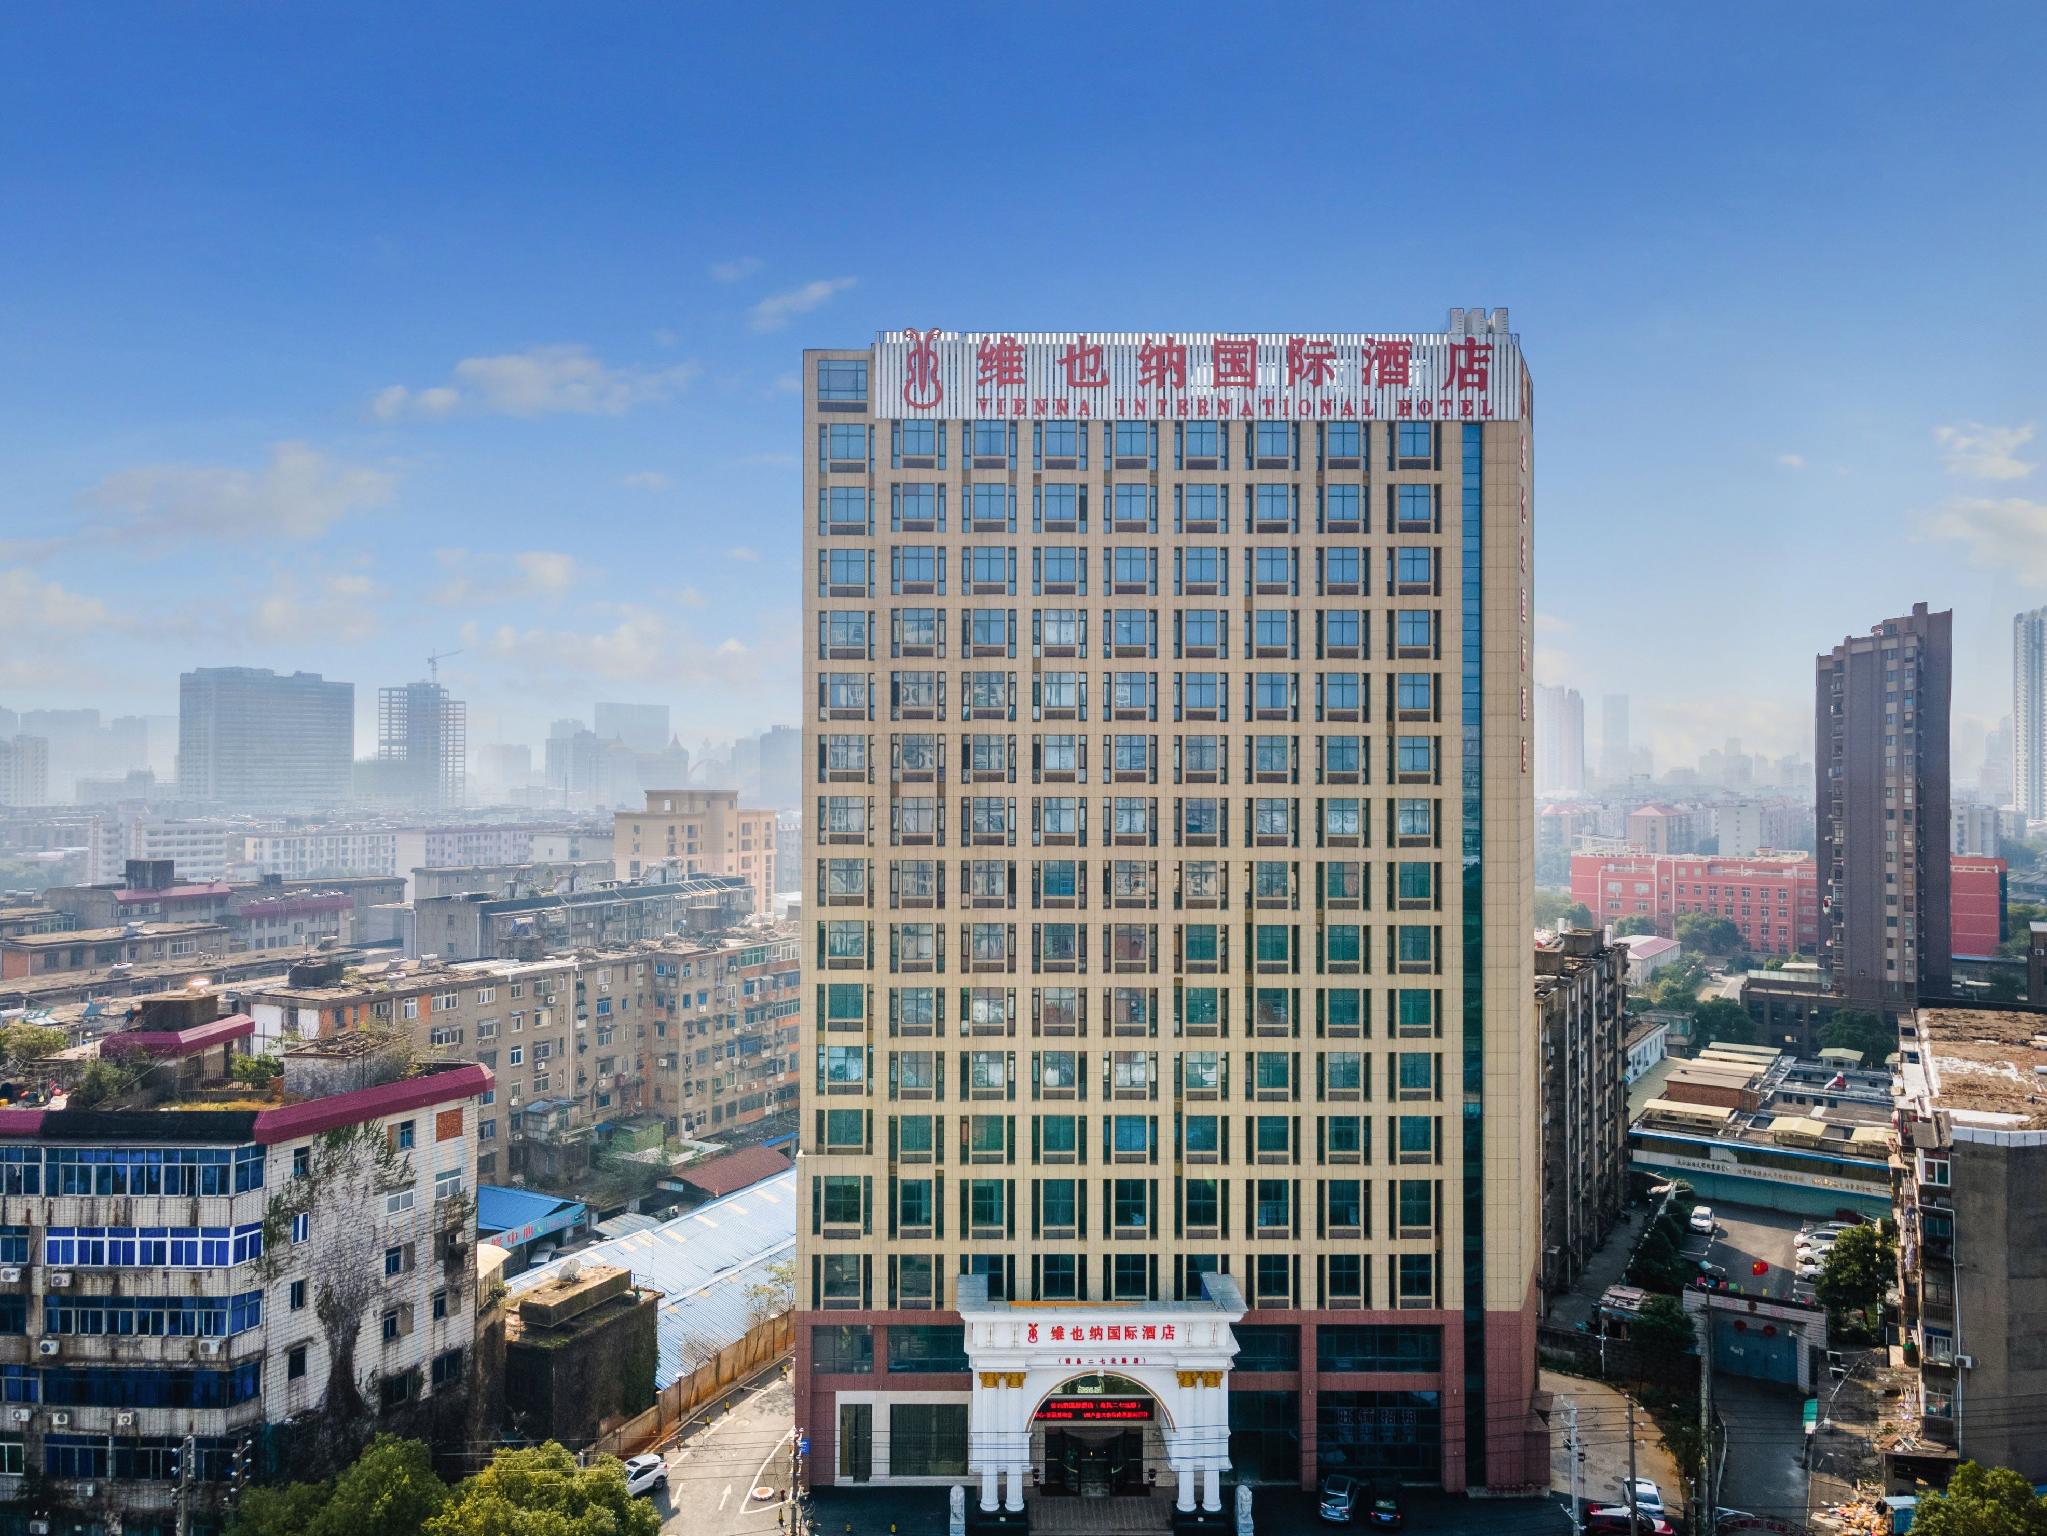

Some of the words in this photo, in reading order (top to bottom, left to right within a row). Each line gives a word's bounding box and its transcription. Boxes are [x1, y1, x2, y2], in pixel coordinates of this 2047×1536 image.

[976, 335, 1494, 392] 维也纳国际酒店
[977, 398, 1091, 416] VIENNA
[1117, 398, 1375, 416] INTERNATIONAL
[1397, 399, 1494, 416] HOTEL
[1050, 1324, 1175, 1341] 维也纳国际酒店
